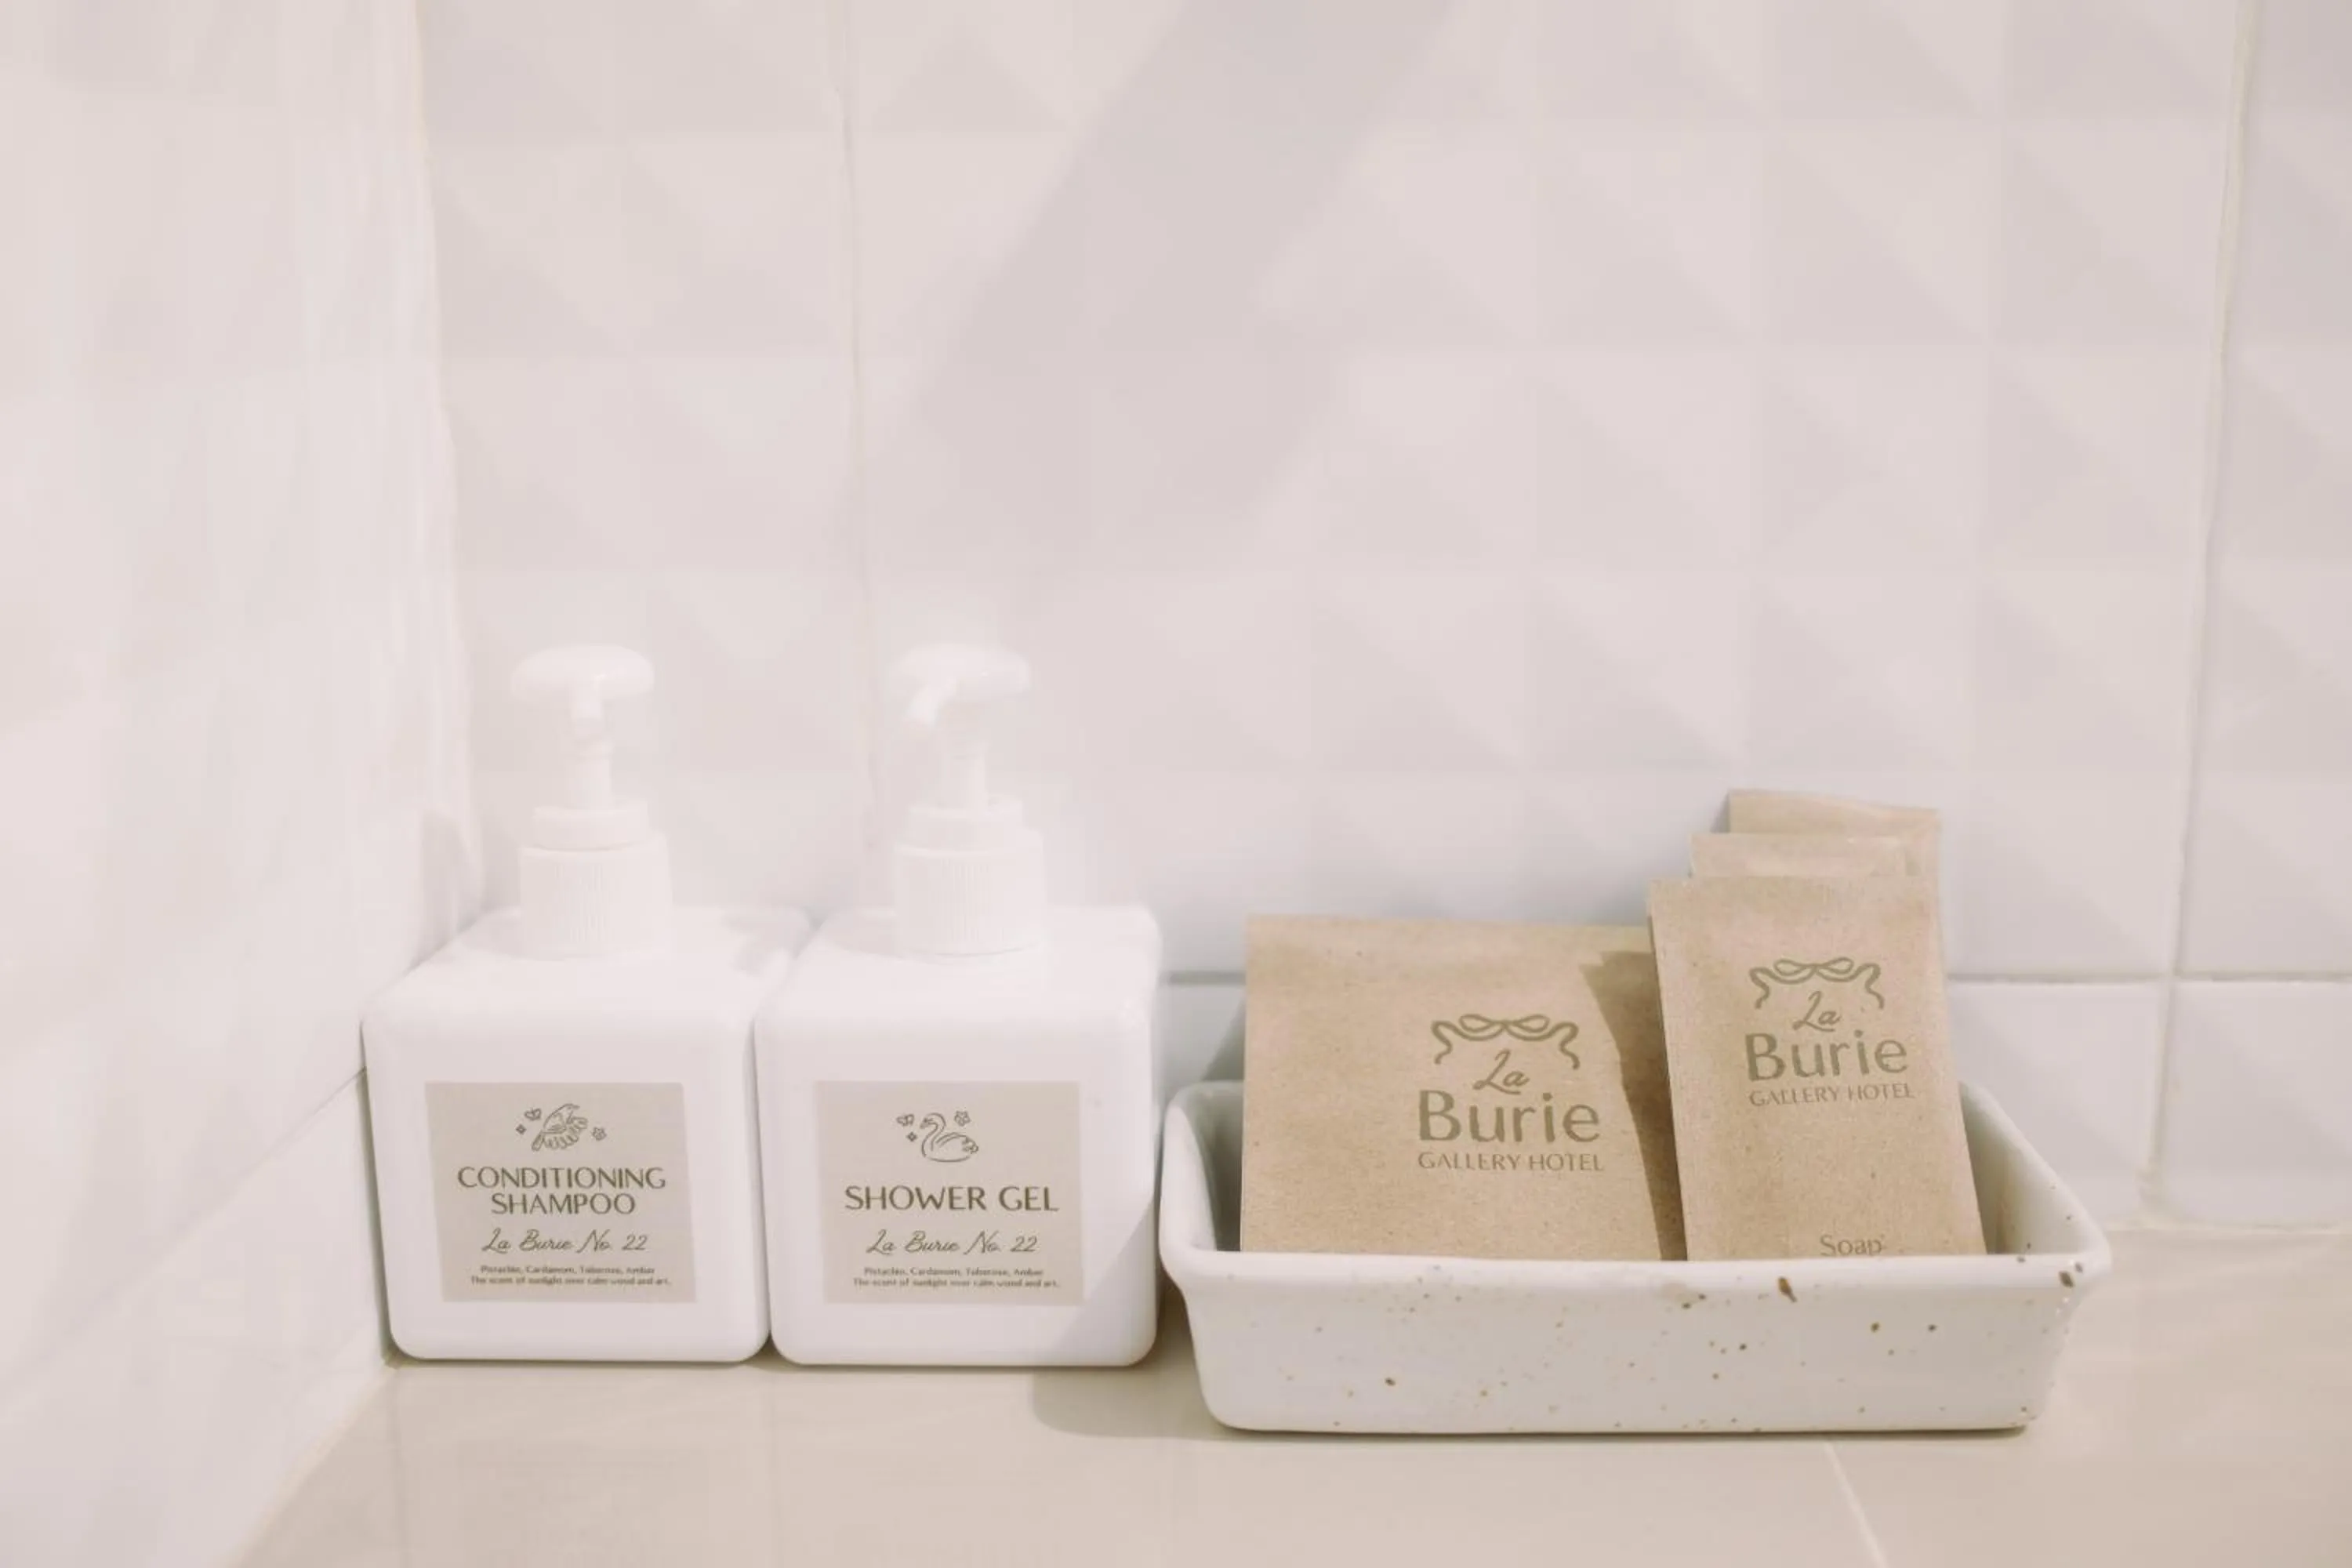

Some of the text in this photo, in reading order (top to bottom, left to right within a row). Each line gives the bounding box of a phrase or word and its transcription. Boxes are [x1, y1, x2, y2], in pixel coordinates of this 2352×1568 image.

[1792, 990, 1842, 1033] La
[1744, 1029, 1909, 1082] Burie
[1472, 1048, 1530, 1095] La
[1748, 1082, 1916, 1107] GALLERY HOTEL
[1419, 1089, 1600, 1143] Burie
[1417, 1151, 1605, 1172] GALLERY HOTEL
[457, 1166, 666, 1189] CONDITIONING
[491, 1192, 636, 1214] SHAMPOO
[844, 1185, 1060, 1212] SHOWER GEL
[481, 1227, 511, 1254] La
[621, 1233, 648, 1251] 22
[866, 1229, 897, 1255] La
[1009, 1235, 1038, 1253] 22
[1820, 1233, 1883, 1257] Soap
[471, 1276, 486, 1284] The
[516, 1276, 525, 1284] of
[853, 1278, 869, 1287] The
[899, 1278, 909, 1287] of
